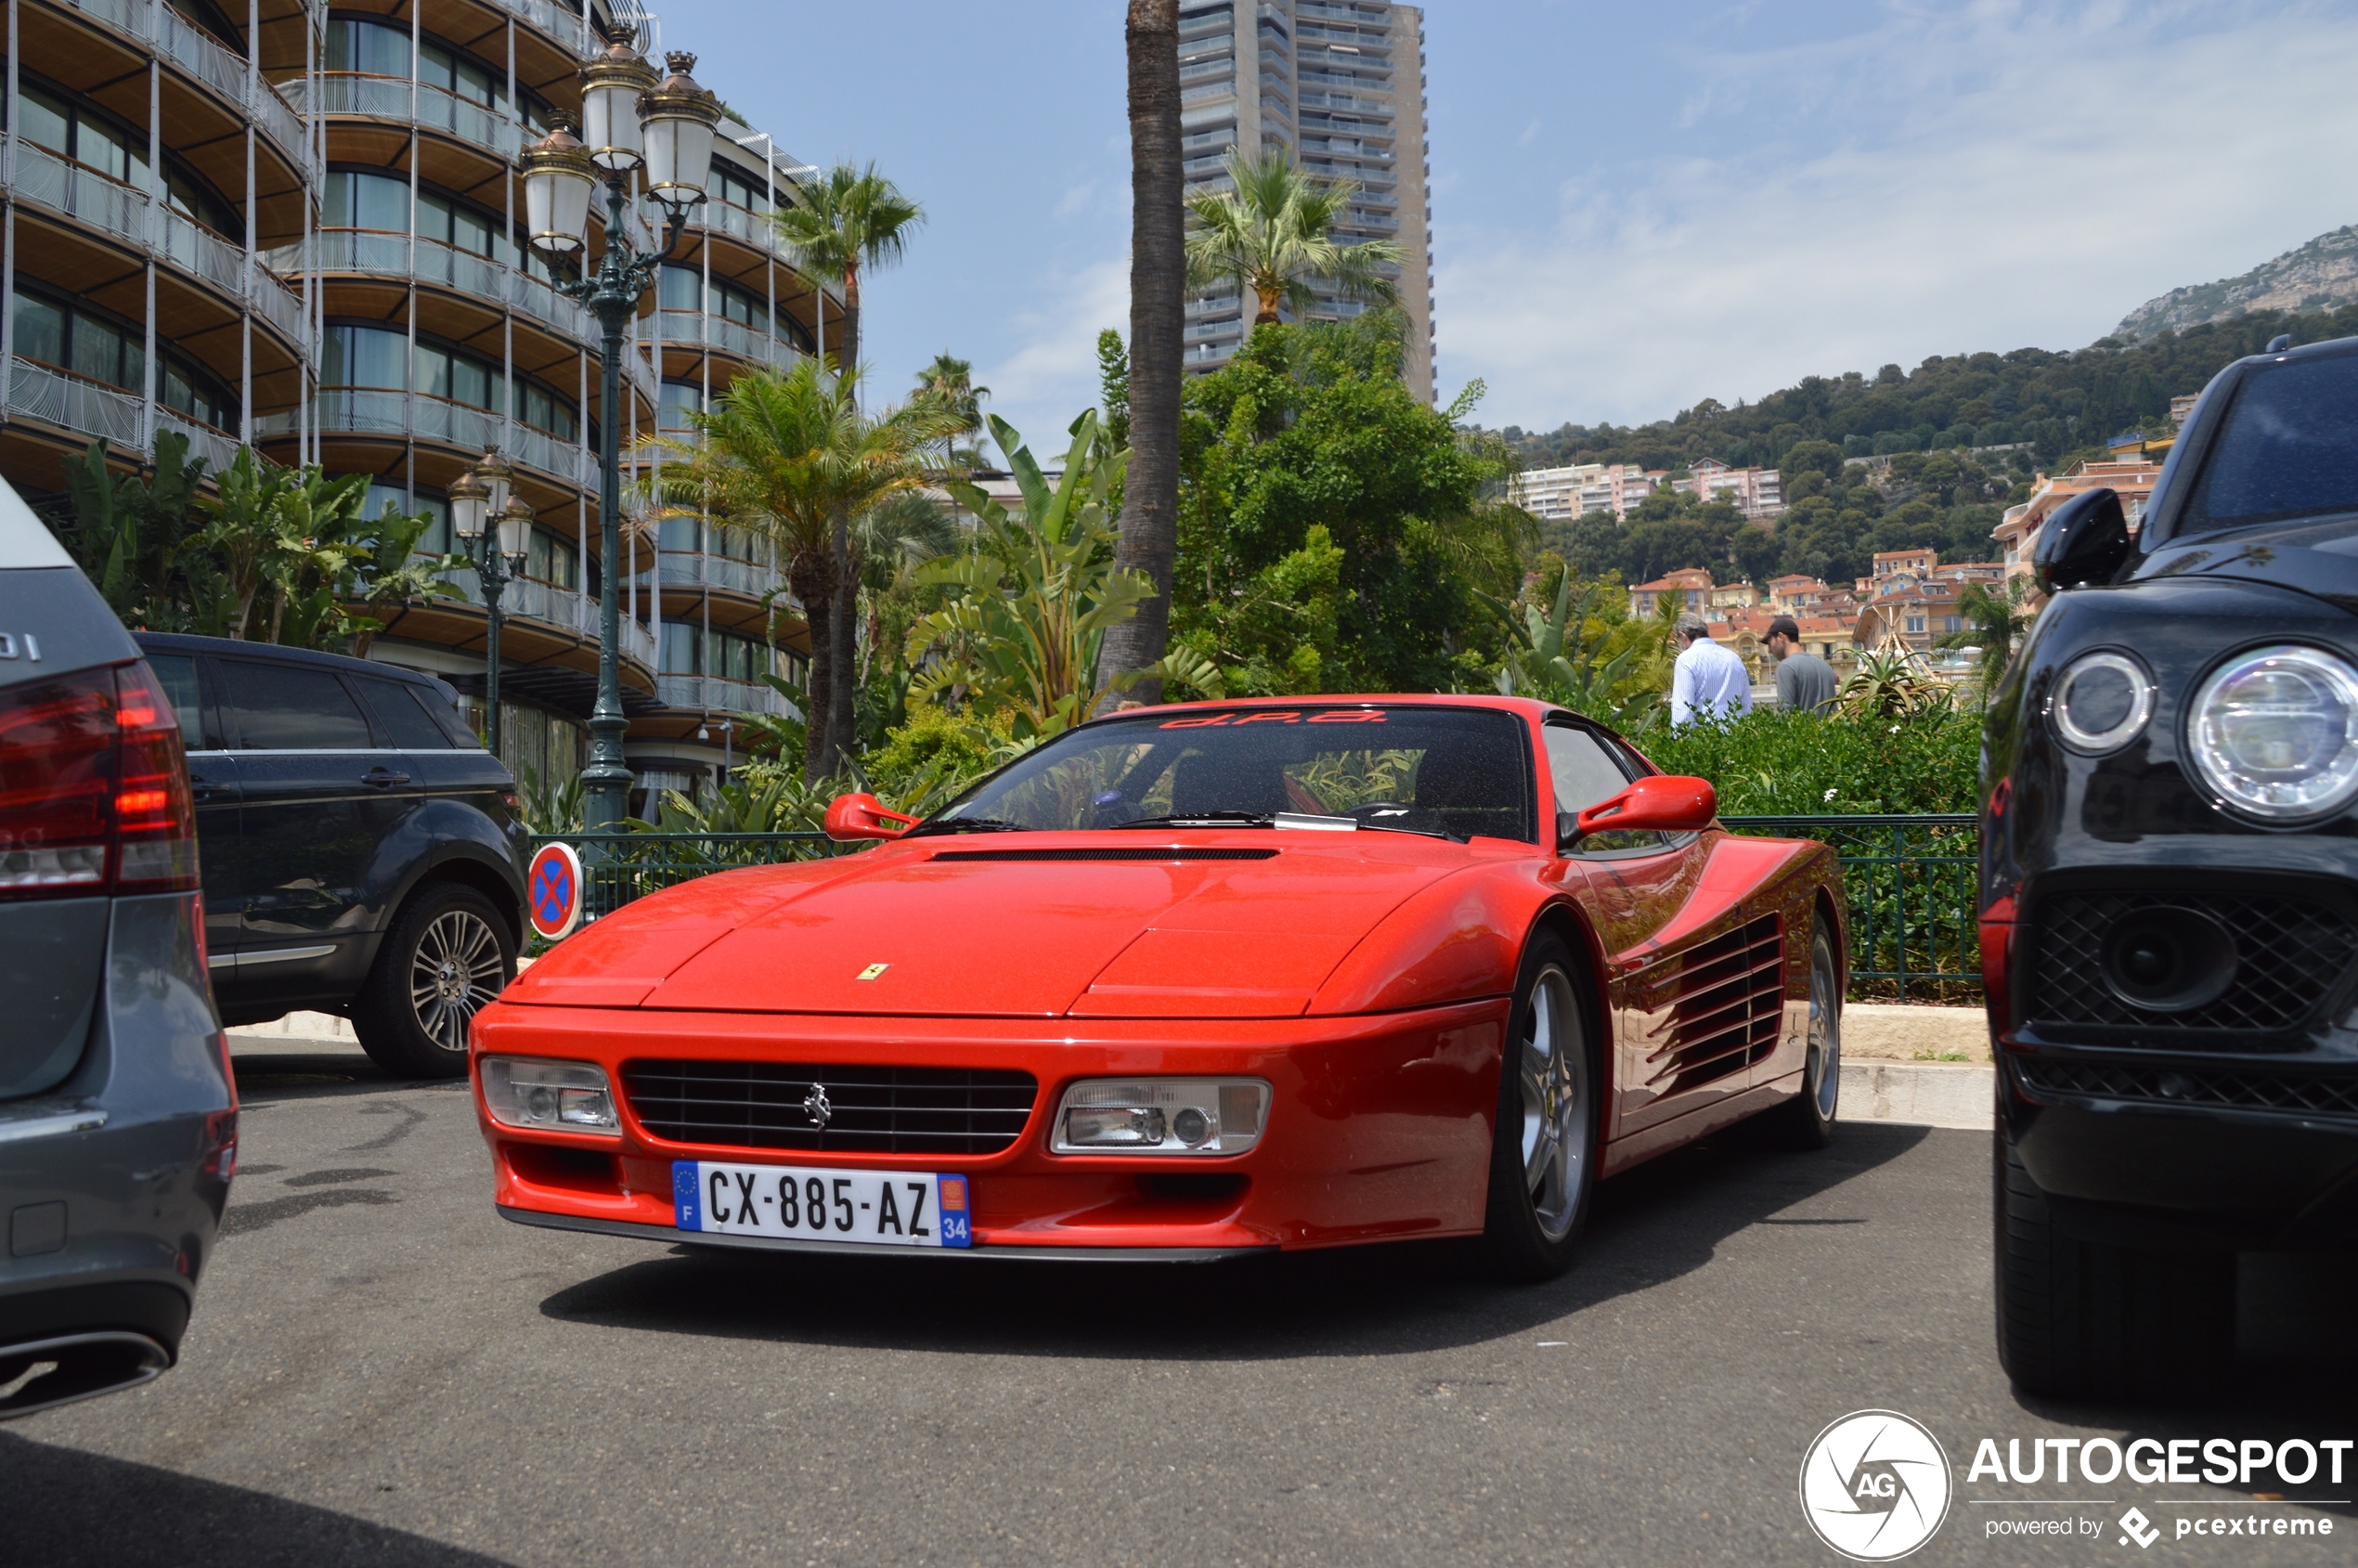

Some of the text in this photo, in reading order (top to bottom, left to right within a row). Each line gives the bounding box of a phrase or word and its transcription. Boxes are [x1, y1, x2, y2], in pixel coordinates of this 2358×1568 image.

[682, 1205, 693, 1221] F
[709, 1170, 929, 1237] CX-885-AZ
[943, 1217, 967, 1239] 34
